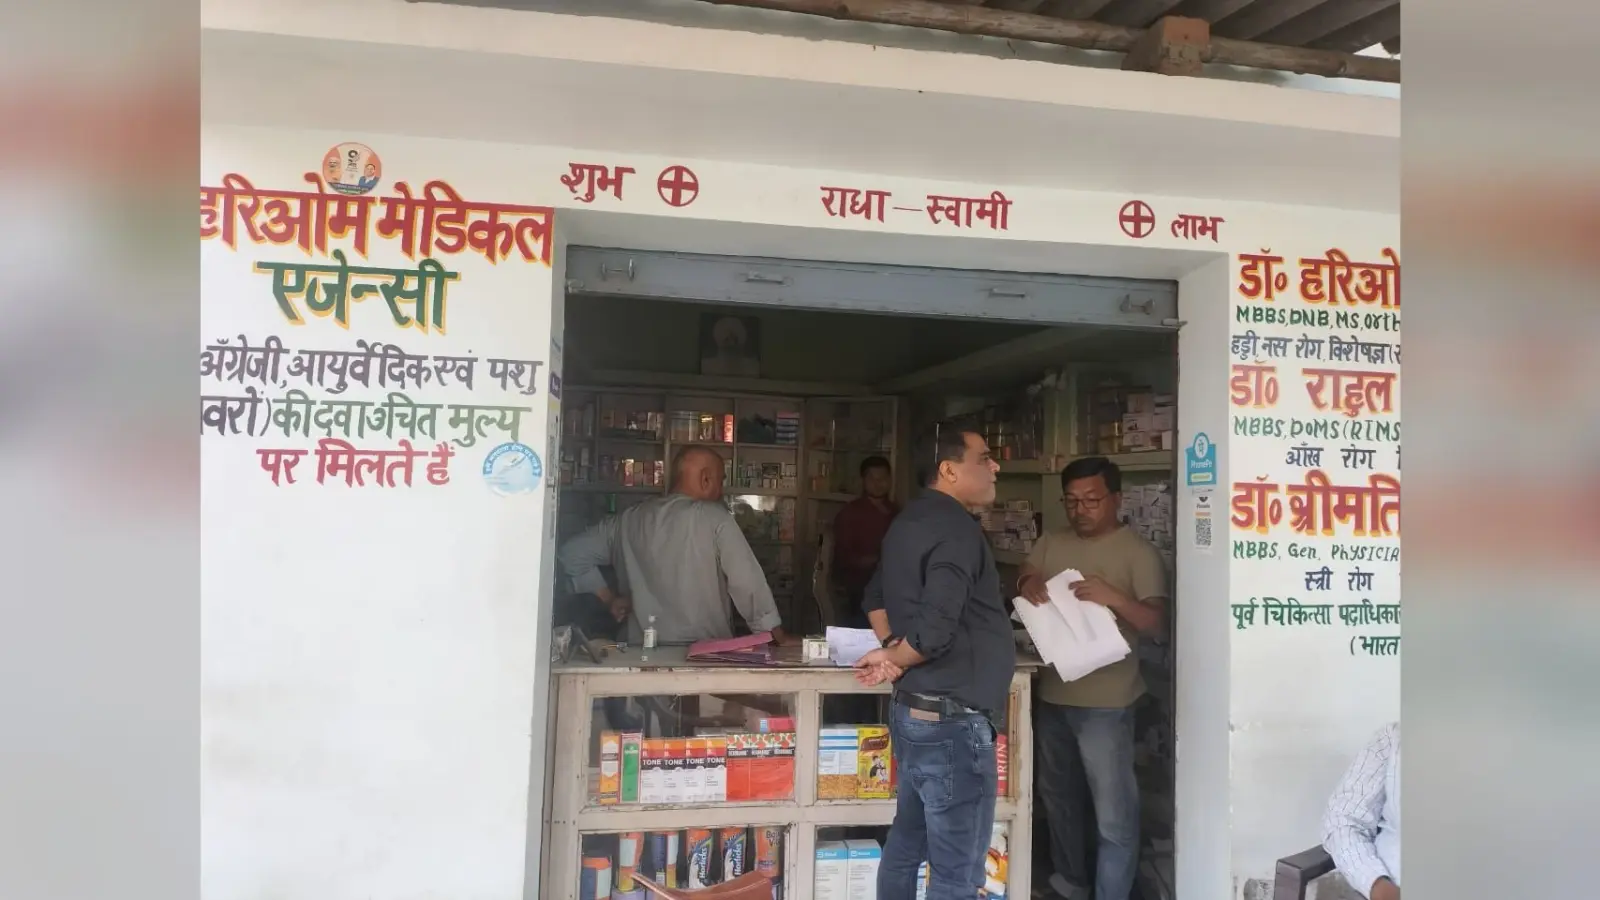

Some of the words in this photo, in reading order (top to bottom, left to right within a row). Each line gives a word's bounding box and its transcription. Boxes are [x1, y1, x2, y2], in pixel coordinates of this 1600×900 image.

[560, 162, 636, 203] शुभ
[375, 180, 553, 268] मेडिकल
[820, 186, 892, 223] राधा
[926, 190, 1012, 231] स्वामी
[1171, 213, 1225, 243] लाभ
[252, 248, 462, 337] एजेन्सी
[1261, 336, 1293, 358] नस
[487, 358, 544, 395] पशु
[1301, 367, 1397, 419] राहुल
[366, 392, 444, 440] उचित
[448, 403, 532, 448] मुल्य
[256, 448, 308, 486] पर
[314, 437, 428, 488] मिलते
[426, 441, 455, 488] हैं
[1285, 441, 1324, 467] आँख
[1340, 444, 1376, 469] रोग
[1305, 566, 1333, 591] स्त्री
[1348, 566, 1374, 591] रोग
[1231, 597, 1259, 629] पूर्व
[1262, 597, 1334, 626] चिकित्सा
[643, 758, 661, 766] TONE
[664, 758, 683, 766] TONE
[686, 757, 705, 765] TONE
[707, 756, 725, 764] TONE
